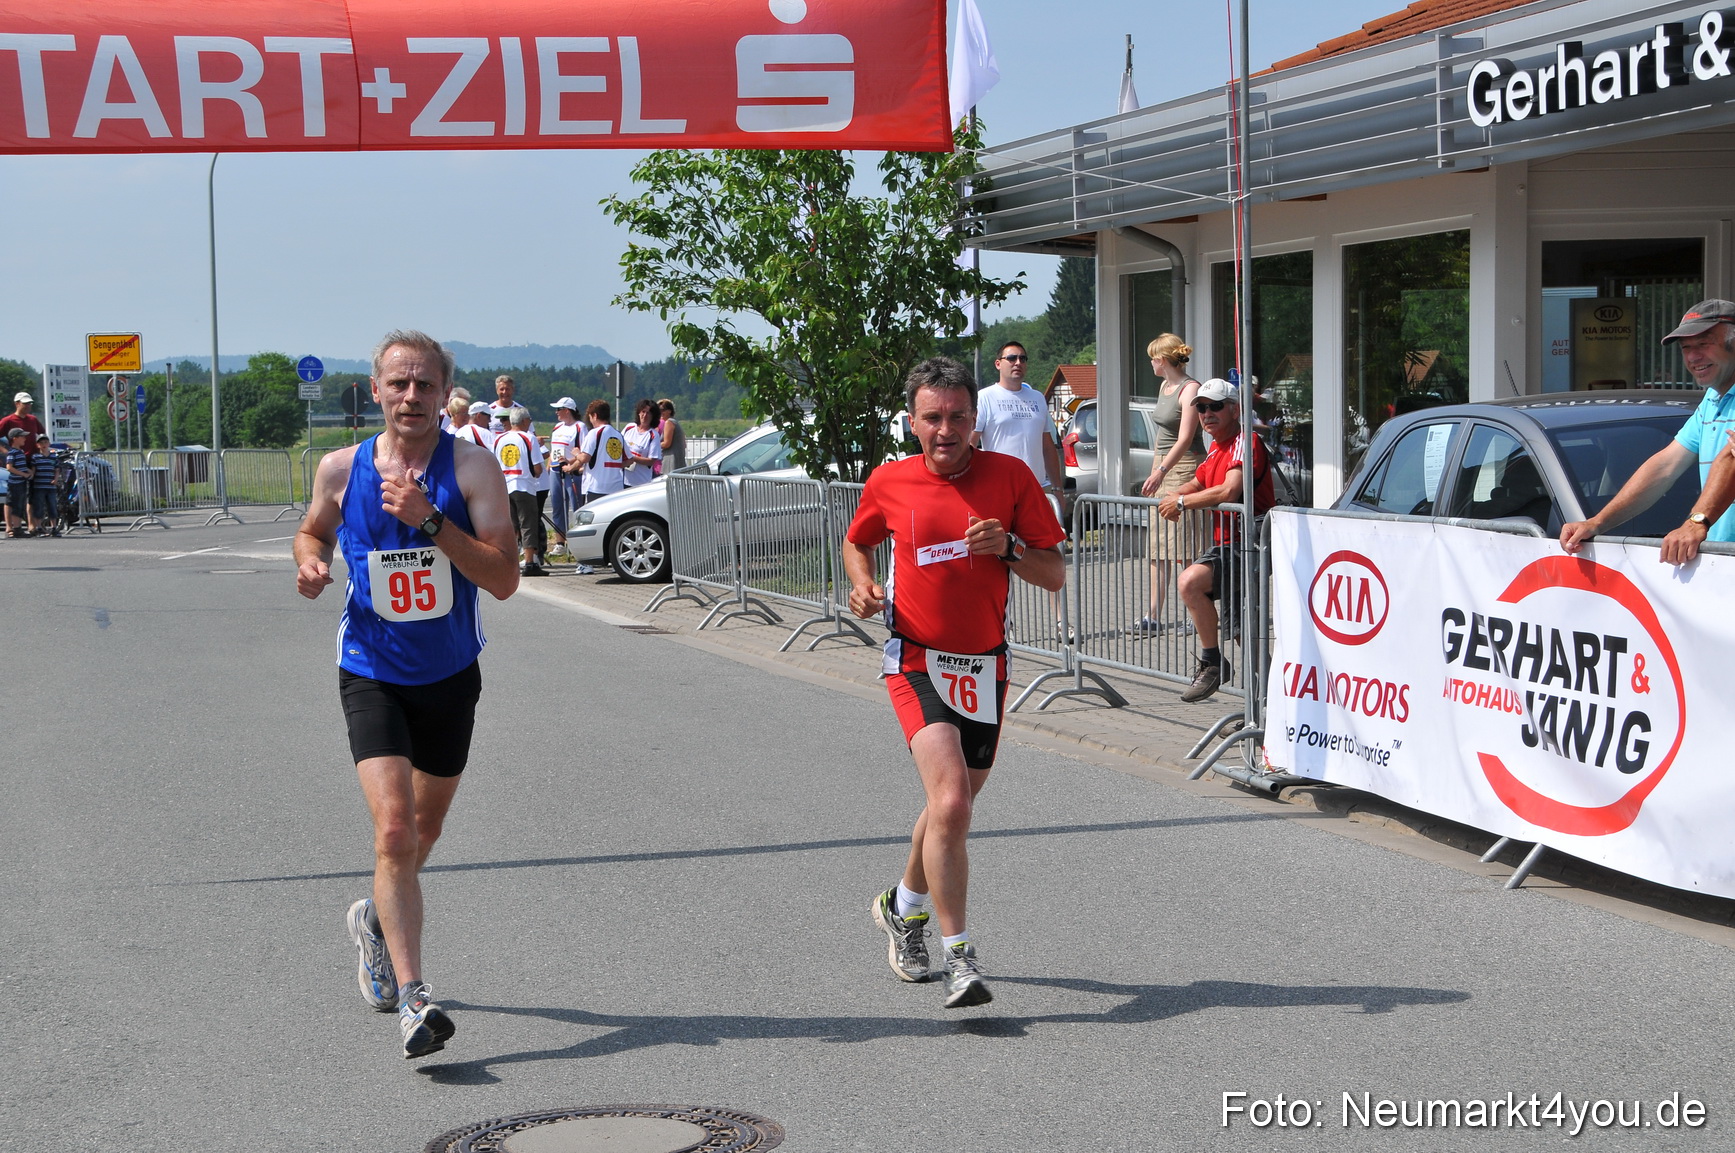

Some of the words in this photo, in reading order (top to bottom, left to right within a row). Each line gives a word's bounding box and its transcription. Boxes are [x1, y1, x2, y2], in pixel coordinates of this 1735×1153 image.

[1466, 23, 1674, 127] Gerhart
[1692, 10, 1732, 81] &
[1599, 309, 1619, 319] KIA
[1582, 326, 1598, 334] KIA
[1600, 326, 1631, 334] MOTORS
[93, 339, 136, 351] Sengenthal
[1551, 348, 1570, 356] GER
[381, 551, 418, 562] MEYER
[930, 547, 954, 558] DEHN
[381, 560, 419, 569] WERBUNG
[388, 569, 437, 614] 95
[1324, 573, 1375, 625] KIA
[1441, 607, 1628, 699] GERHART
[1630, 652, 1651, 695] &
[936, 654, 971, 666] MEYER
[936, 662, 969, 673] WERBUNG
[941, 672, 978, 714] 76
[1296, 723, 1342, 751] Power
[1344, 733, 1354, 754] to
[1521, 690, 1652, 775] JÄNIG
